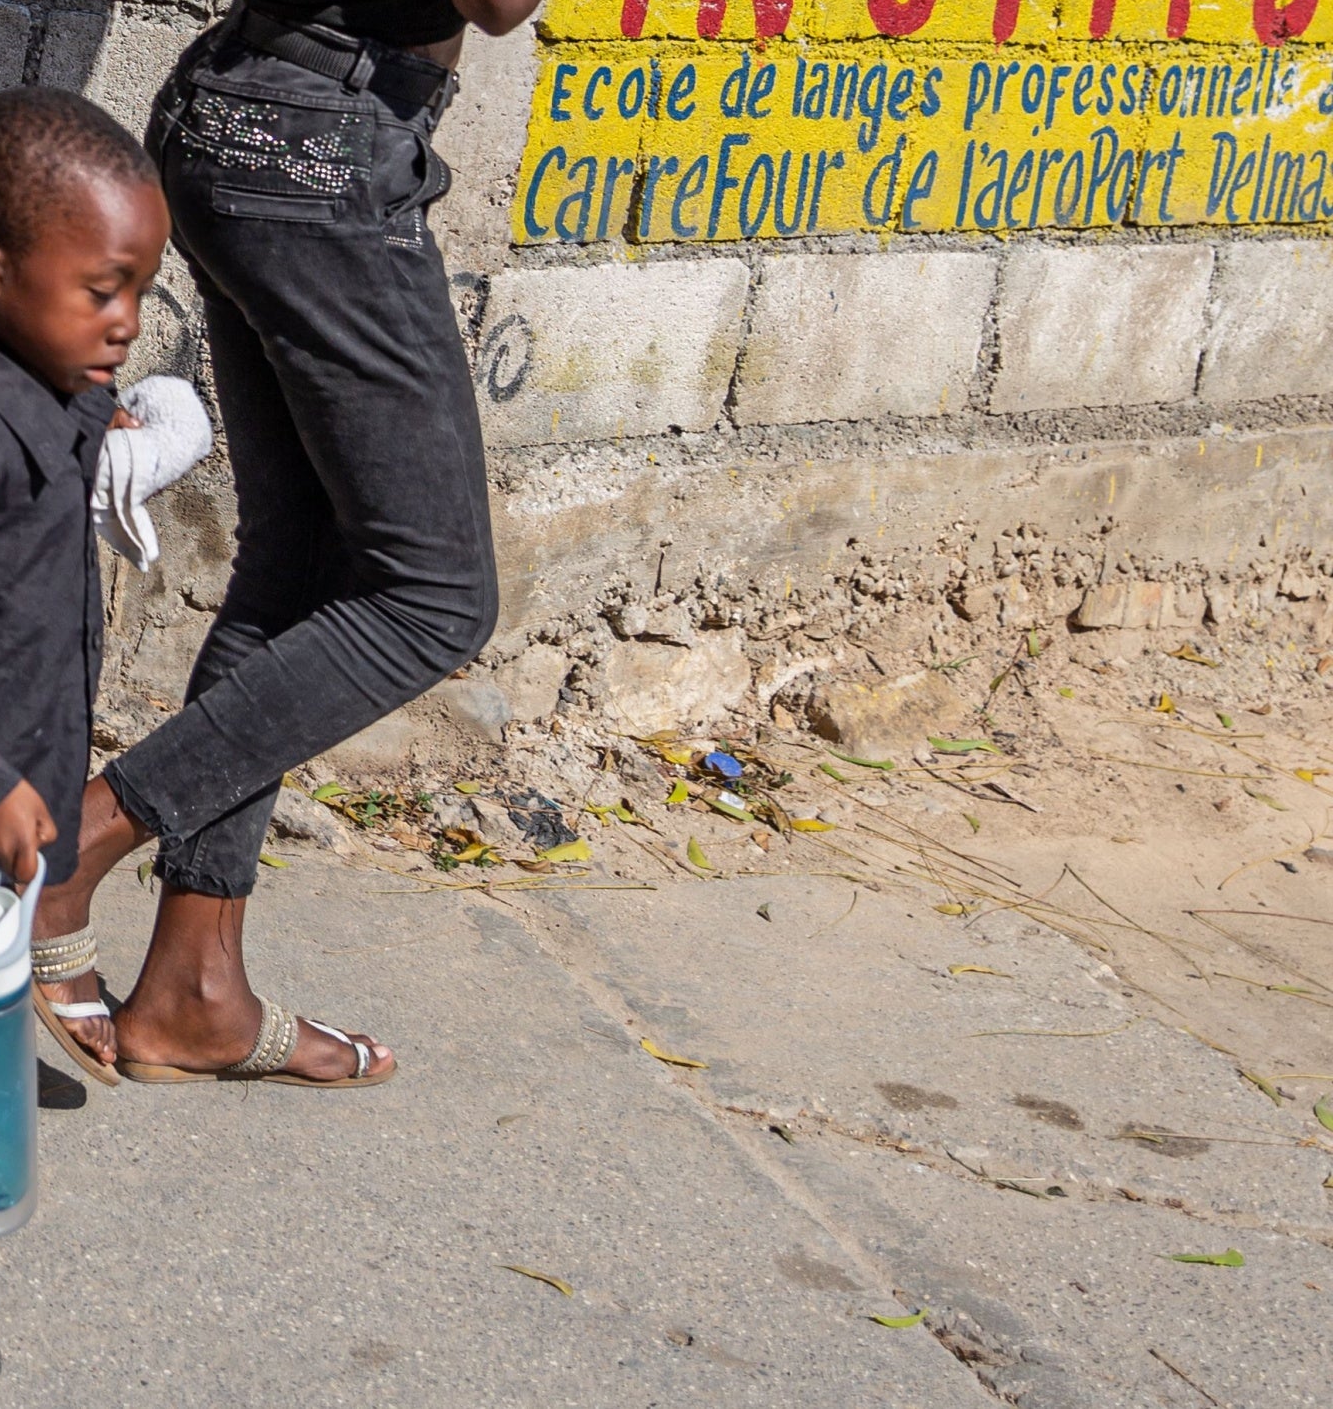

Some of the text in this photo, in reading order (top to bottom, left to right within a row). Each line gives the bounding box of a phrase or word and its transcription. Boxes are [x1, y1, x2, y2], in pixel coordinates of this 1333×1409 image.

[720, 50, 777, 119] de
[792, 56, 942, 152] langes
[862, 132, 940, 228] de
